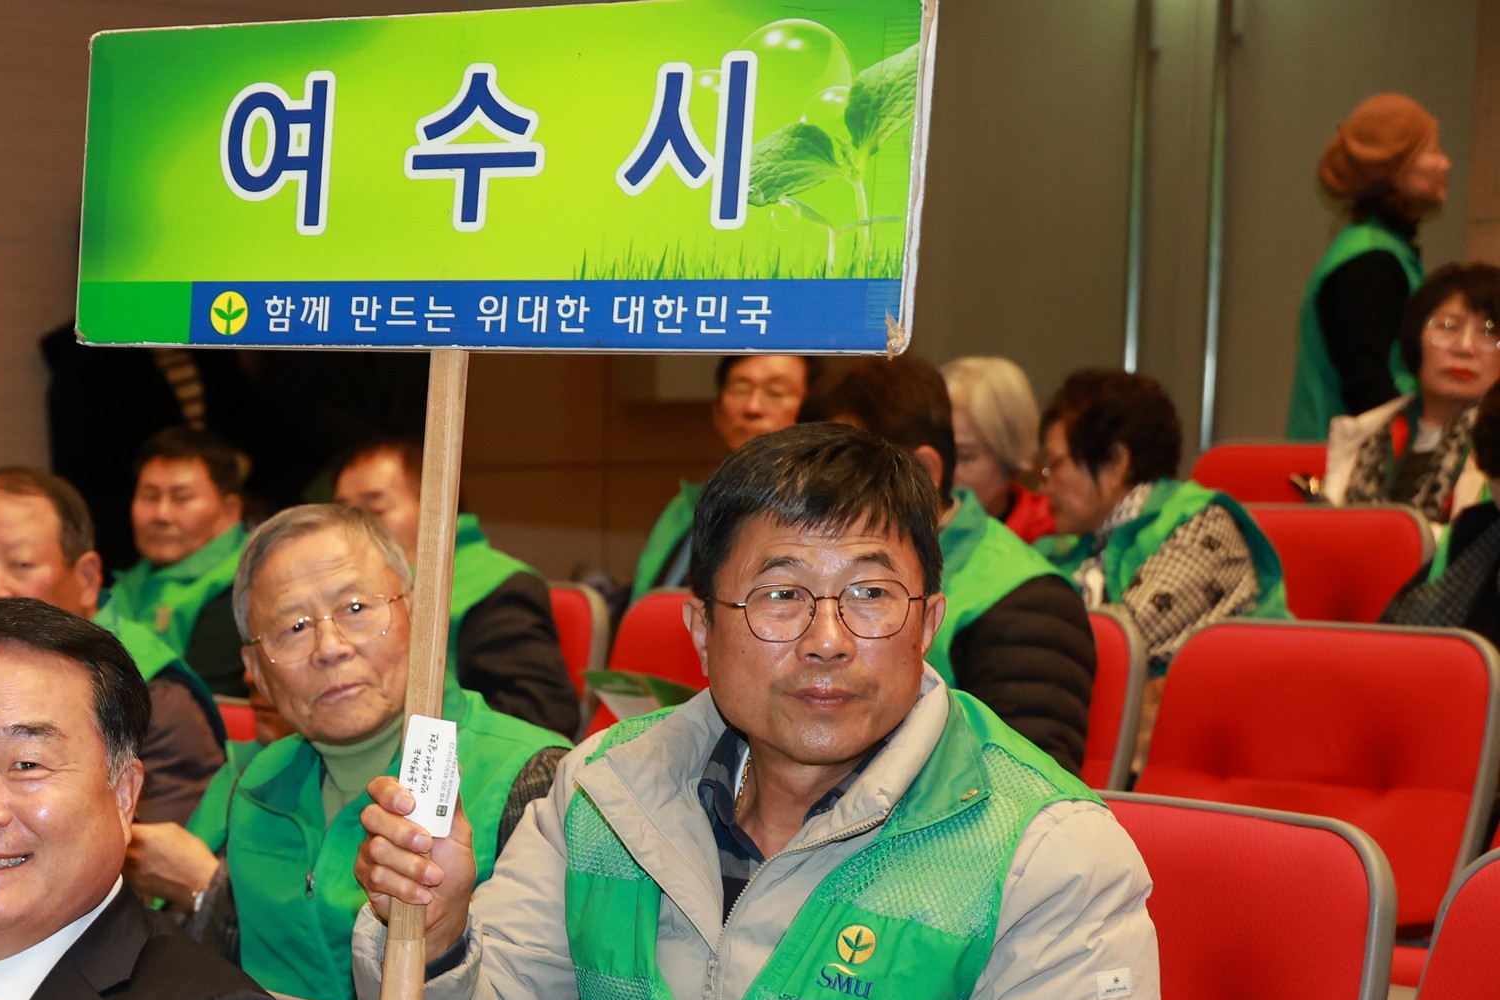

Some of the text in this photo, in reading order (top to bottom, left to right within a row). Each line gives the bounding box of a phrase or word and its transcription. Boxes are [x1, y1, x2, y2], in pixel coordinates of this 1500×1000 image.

[265, 294, 774, 335] 함께 만드는 위대한 대한민국
[816, 967, 873, 1000] SMU
